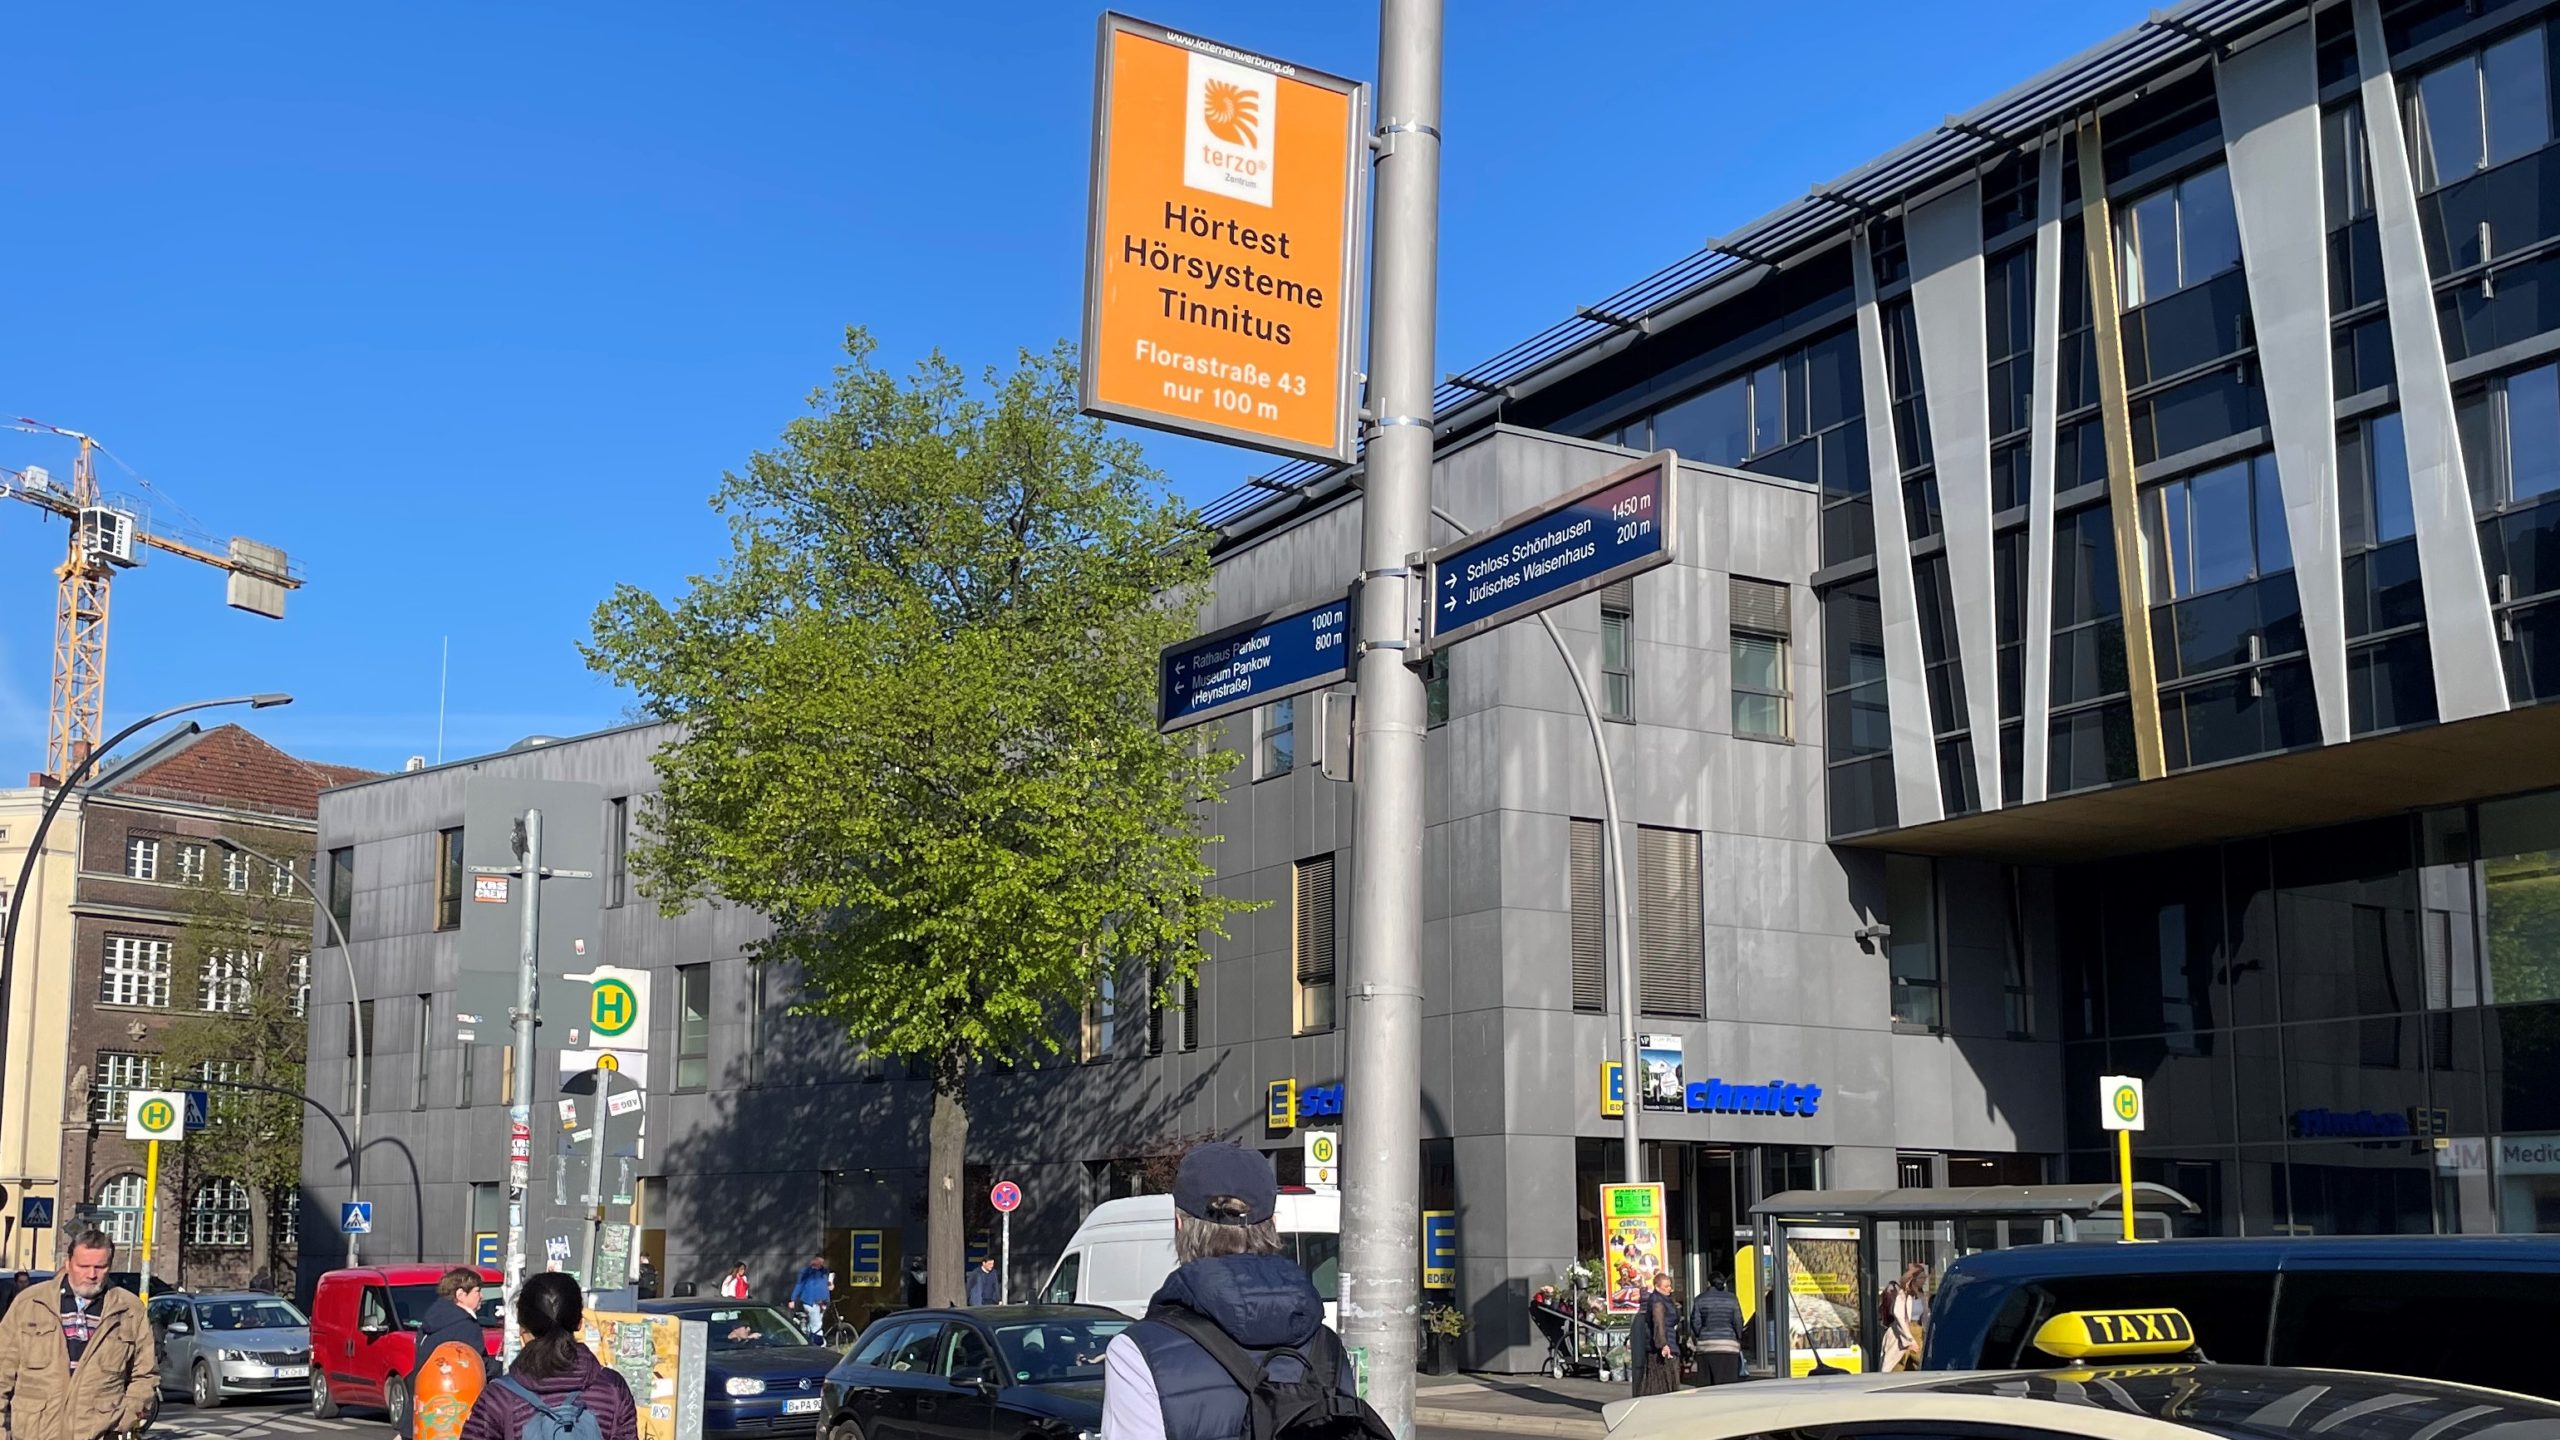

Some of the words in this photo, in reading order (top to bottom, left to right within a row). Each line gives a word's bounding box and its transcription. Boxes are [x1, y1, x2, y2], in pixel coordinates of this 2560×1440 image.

[1166, 31, 1296, 77] www.laternenwerbung.de
[1225, 172, 1257, 189] Zentrum
[1164, 201, 1290, 259] Hörtest
[1124, 234, 1323, 309] Hörsysteme
[1158, 287, 1292, 345] Tinnitus
[1135, 339, 1271, 388] Florastraße
[1277, 372, 1307, 396] 43
[1163, 380, 1204, 403] nur
[1212, 388, 1252, 414] 100
[1257, 401, 1278, 420] m
[1466, 552, 1510, 582] Schloss
[1511, 518, 1591, 563] Schönhausen
[1611, 500, 1638, 521] 1450
[1640, 493, 1651, 509] m
[1466, 573, 1520, 605] Jüdisches
[1522, 541, 1596, 582] Waisenhaus
[1616, 522, 1637, 545] 200
[1639, 519, 1650, 535] m
[1192, 649, 1231, 671] Rathaus
[1232, 634, 1271, 657] Pankow
[1311, 614, 1332, 632] 1000
[1334, 610, 1343, 623] m
[1192, 667, 1231, 690] Museum
[1233, 655, 1272, 677] Pankow
[1315, 635, 1332, 651] 800
[1333, 631, 1342, 645] m
[1191, 674, 1252, 709] (Heynstraße)
[596, 991, 623, 1023] H
[148, 1106, 166, 1125] H
[1686, 1078, 1822, 1115] chmitt
[2121, 1093, 2133, 1113] H
[854, 1234, 880, 1272] E
[852, 1275, 880, 1284] EDEKA
[1427, 1273, 1456, 1284] EDEK
[2093, 1314, 2178, 1342] TAXI
